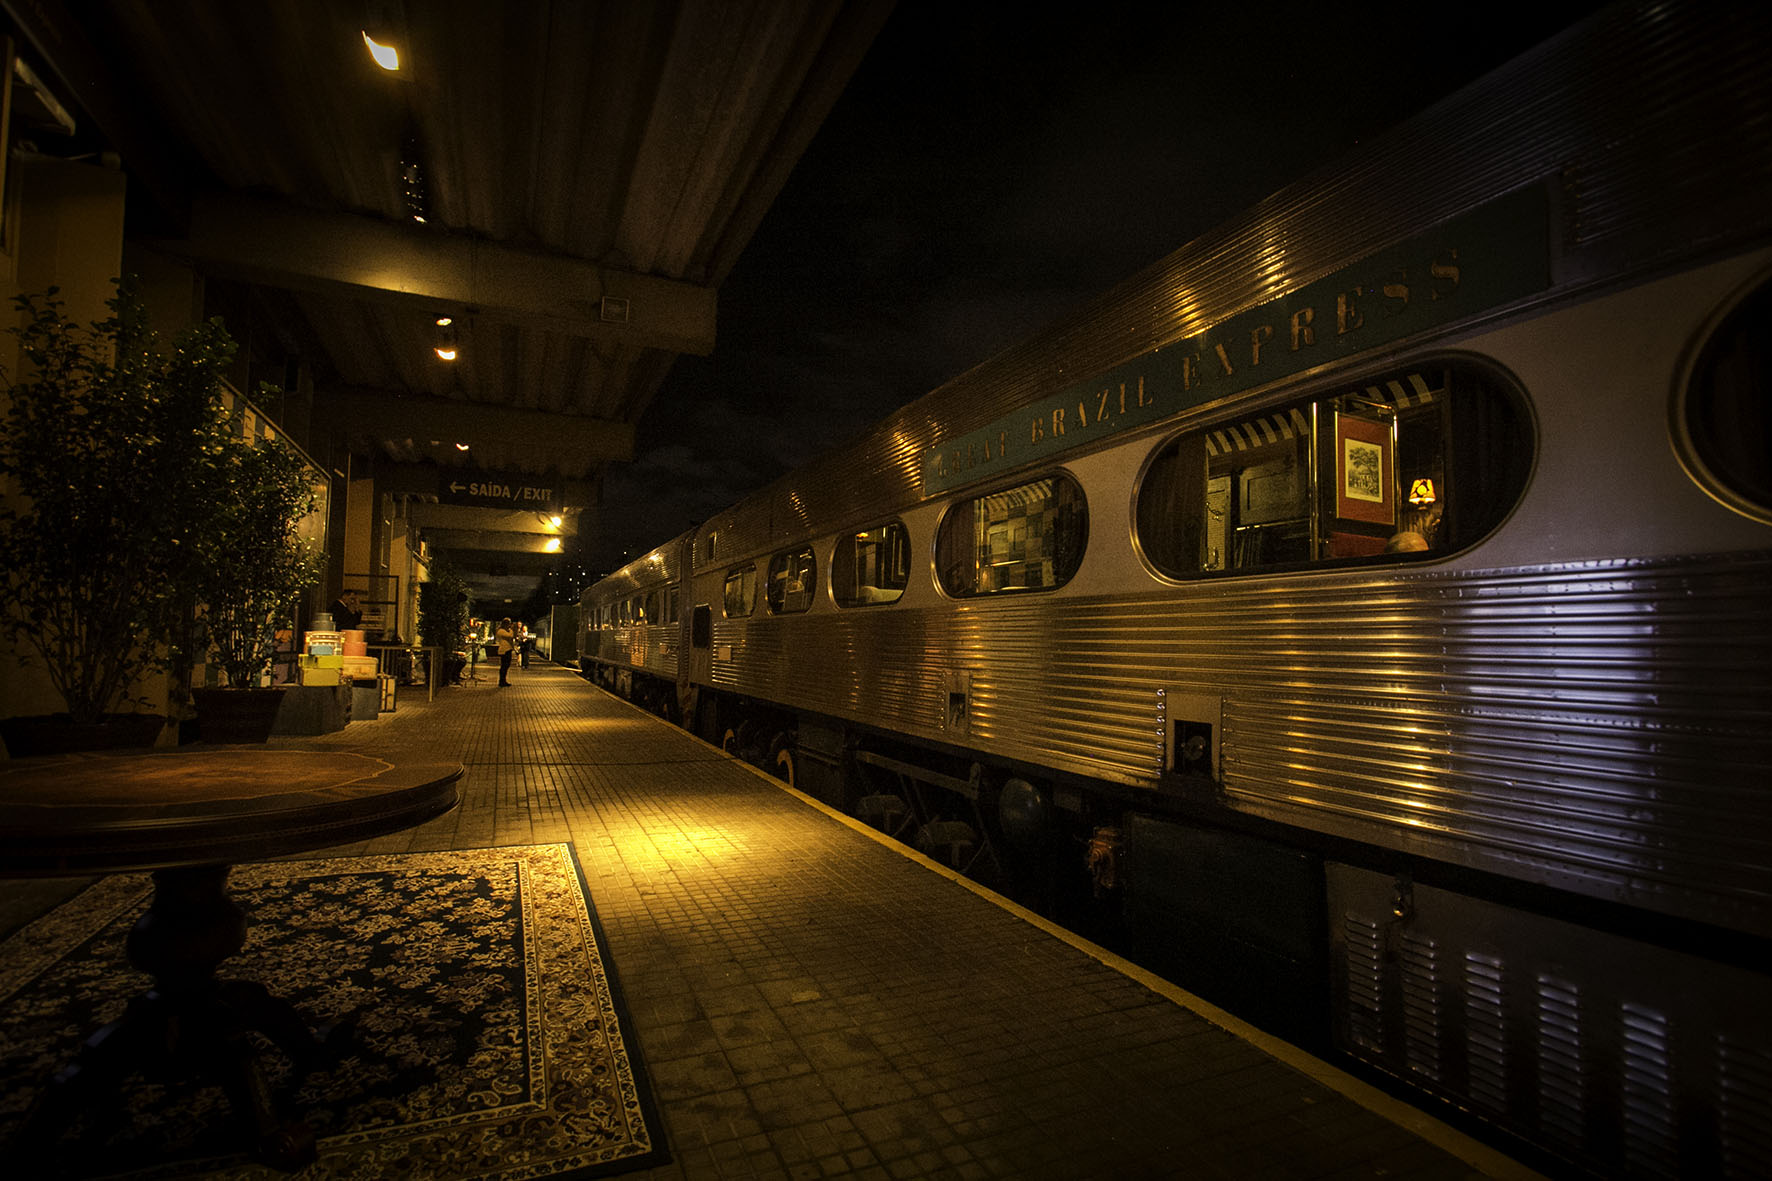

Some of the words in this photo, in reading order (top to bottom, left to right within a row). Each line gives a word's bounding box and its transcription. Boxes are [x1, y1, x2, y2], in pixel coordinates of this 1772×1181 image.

[1031, 375, 1154, 446] BRAZIL
[1183, 247, 1461, 391] EXPRESS
[523, 487, 553, 502] EXIT
